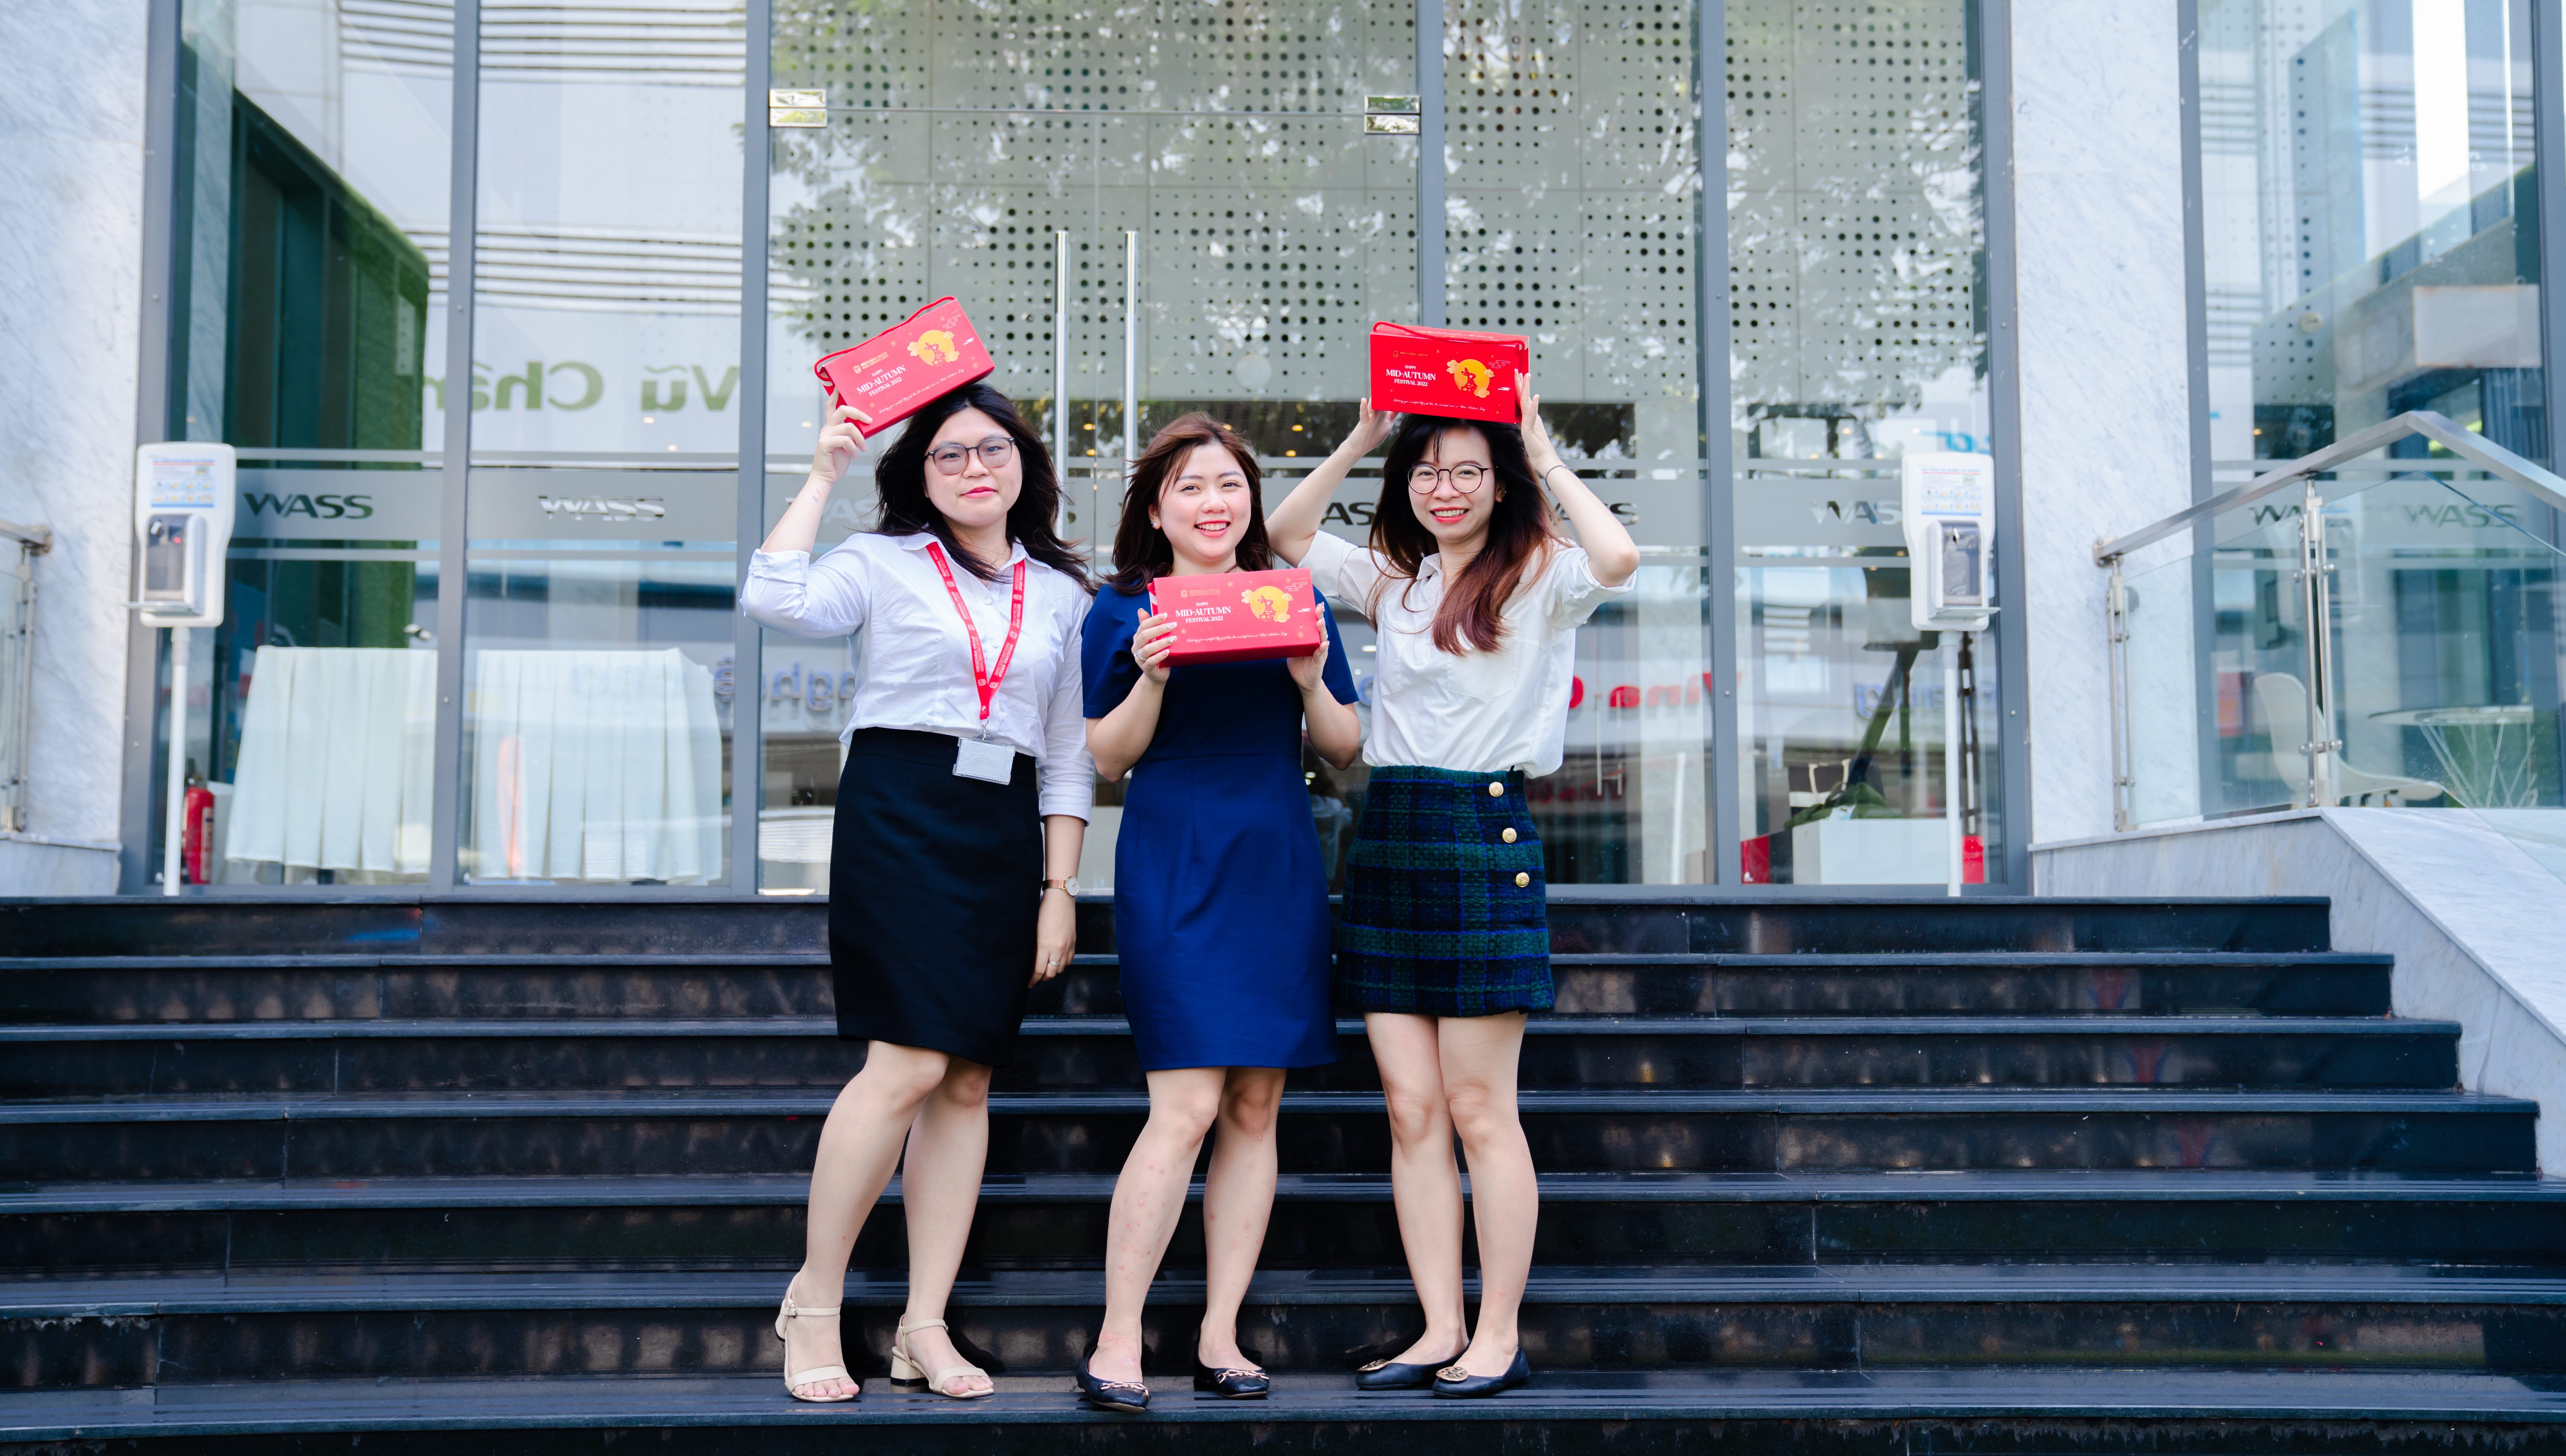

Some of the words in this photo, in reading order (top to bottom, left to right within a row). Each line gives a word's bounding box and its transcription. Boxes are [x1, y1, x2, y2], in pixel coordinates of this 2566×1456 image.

[856, 365, 906, 394] MID-AUTUMN
[872, 369, 883, 377] HAPPY
[1386, 369, 1436, 381] MID-AUTUMN
[869, 383, 891, 396] FESTIVAL
[890, 377, 902, 386] 2022
[243, 493, 373, 519] WASS
[538, 495, 665, 522] WASS
[1807, 499, 1903, 525] WAS
[2402, 504, 2519, 528] WASS
[1176, 606, 1231, 617] MID-AUTUMN
[1003, 644, 1013, 665] INDOCHINA
